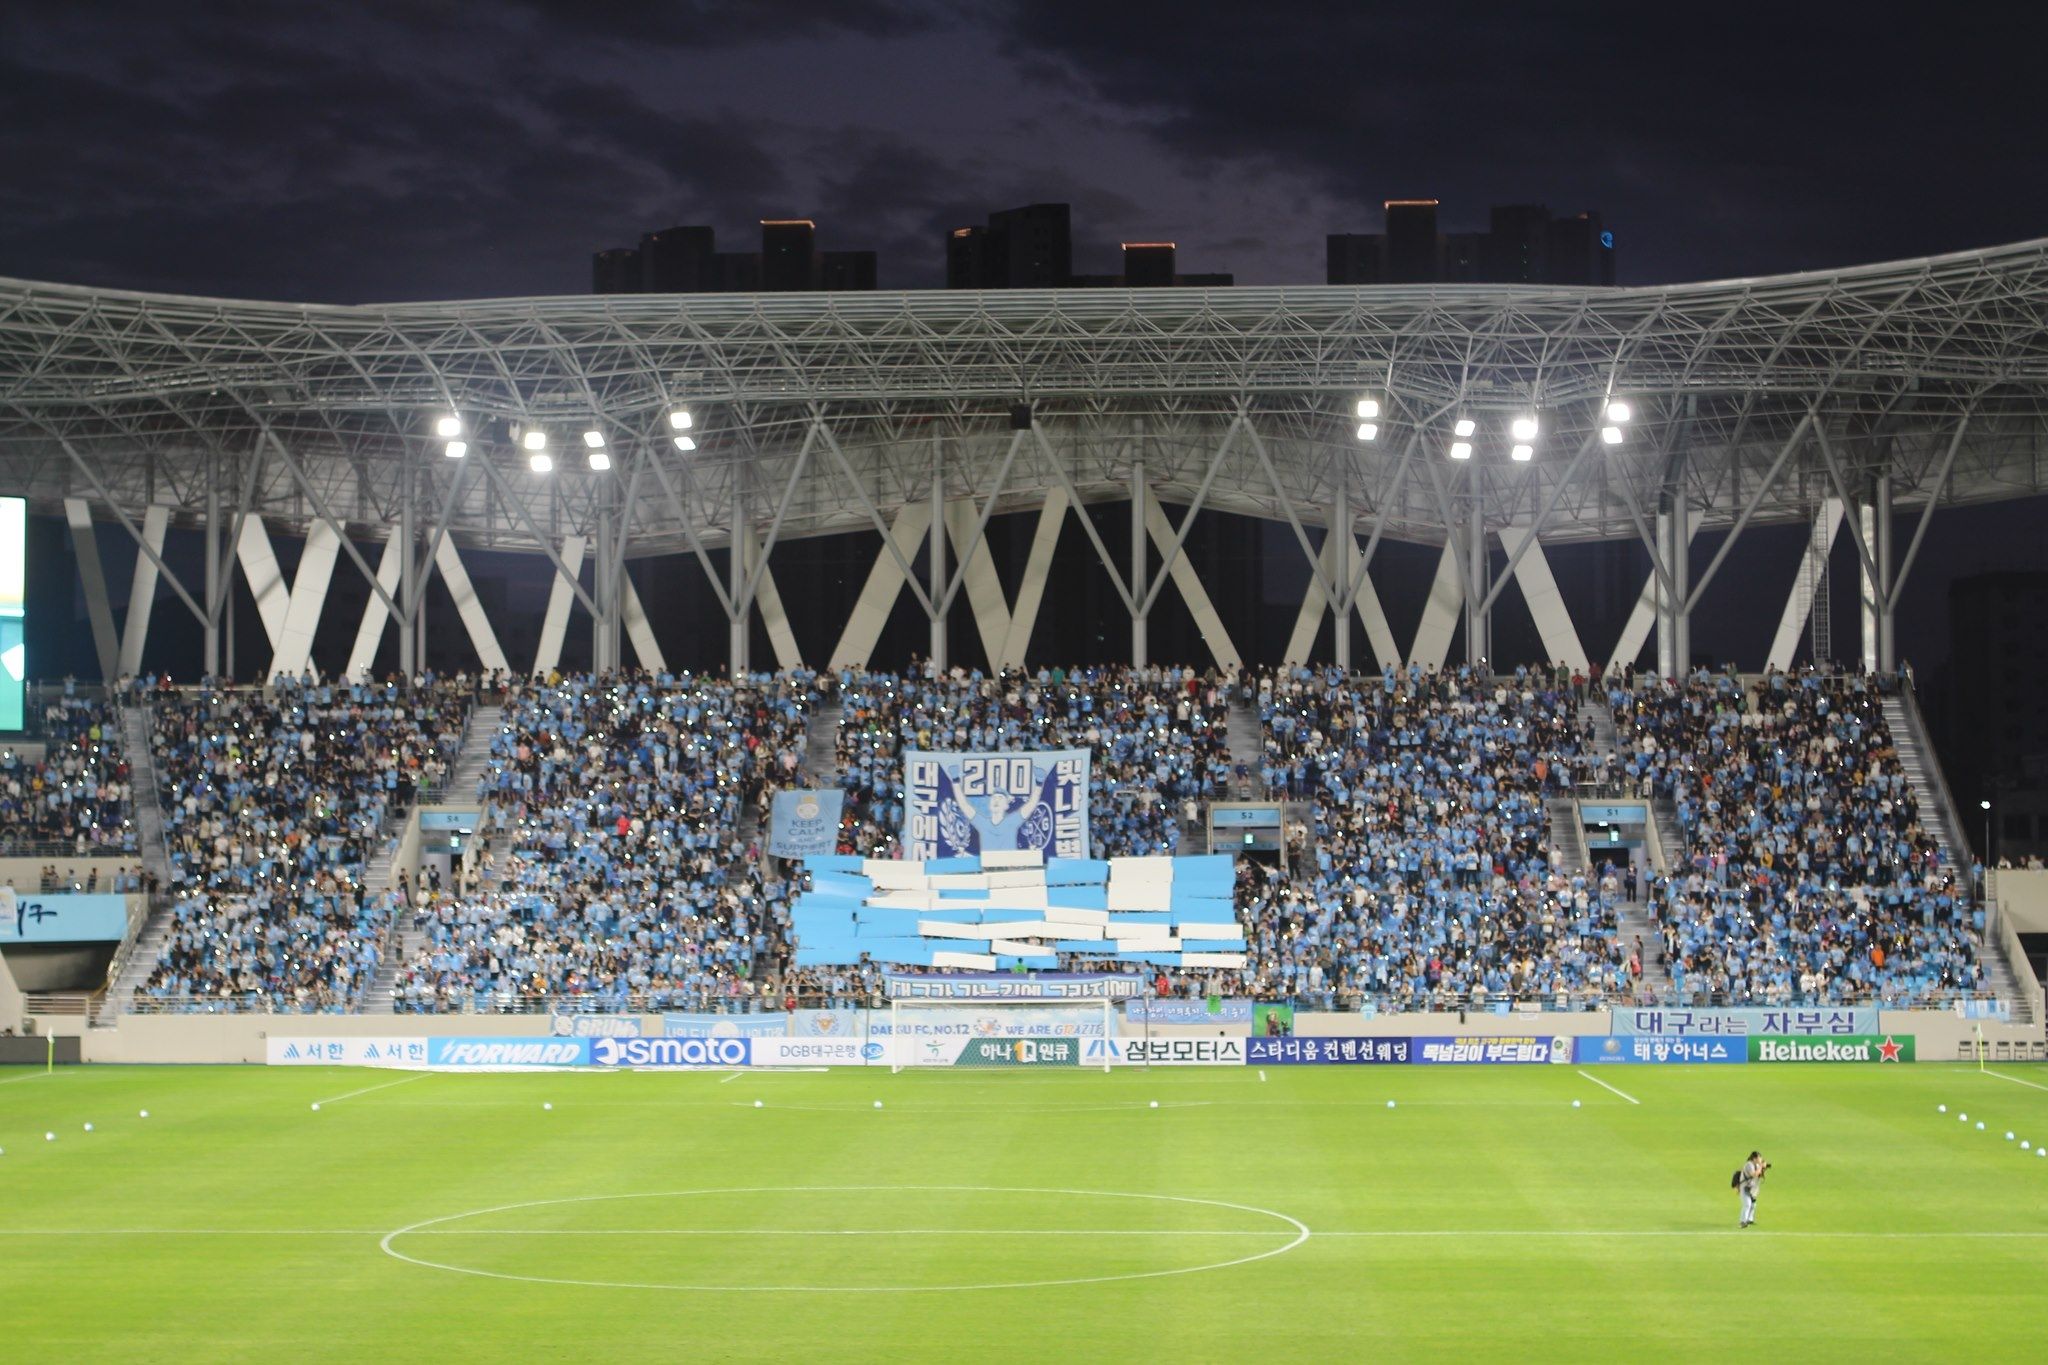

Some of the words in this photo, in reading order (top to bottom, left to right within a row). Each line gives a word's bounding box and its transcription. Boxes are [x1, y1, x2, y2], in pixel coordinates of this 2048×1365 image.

[963, 758, 1032, 796] 200
[788, 826, 825, 836] CALM
[870, 1025, 911, 1035] DAEGU
[1006, 1026, 1024, 1035] WE
[1028, 1026, 1050, 1035] ARE
[1635, 1011, 1748, 1035] 대구라는
[1761, 1011, 1855, 1034] 자부심
[306, 1043, 344, 1061] 서한
[387, 1043, 424, 1061] 서한
[453, 1043, 581, 1063] FORWARD
[780, 1045, 856, 1058] DGB대구은행
[980, 1043, 1012, 1061] 하나
[1039, 1043, 1069, 1062] 원큐
[1126, 1041, 1241, 1062] 삼보모터스
[1250, 1039, 1317, 1061] 스타디움
[1634, 1042, 1728, 1061] 태왕아너스
[1759, 1041, 1869, 1062] Heineken
